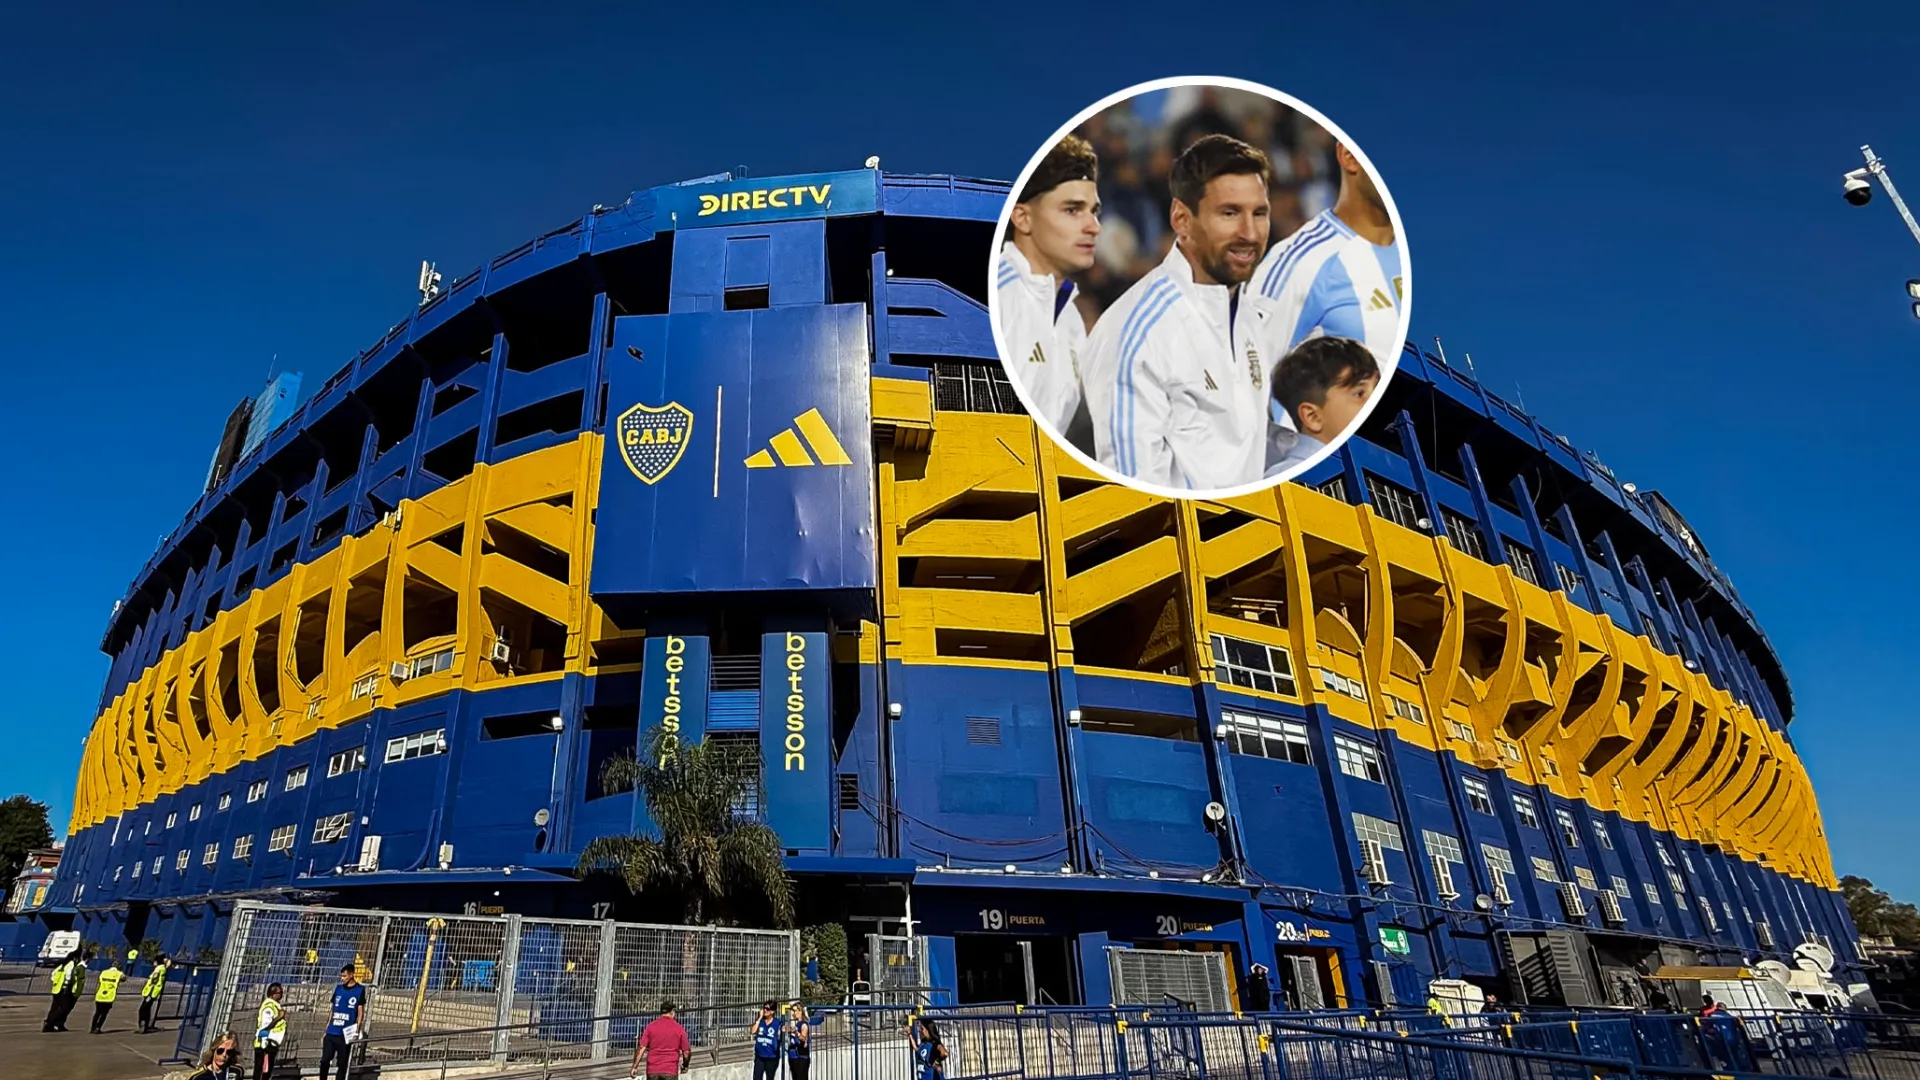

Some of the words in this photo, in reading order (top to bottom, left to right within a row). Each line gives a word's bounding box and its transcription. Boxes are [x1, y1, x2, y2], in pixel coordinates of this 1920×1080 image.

[698, 184, 831, 215] DIRECTV
[626, 428, 682, 445] CABJ
[785, 631, 806, 771] betsson
[463, 902, 477, 916] 16
[592, 902, 611, 919] 17
[979, 909, 1003, 930] 19
[1009, 915, 1046, 925] PUERTA
[1156, 915, 1178, 935] 20
